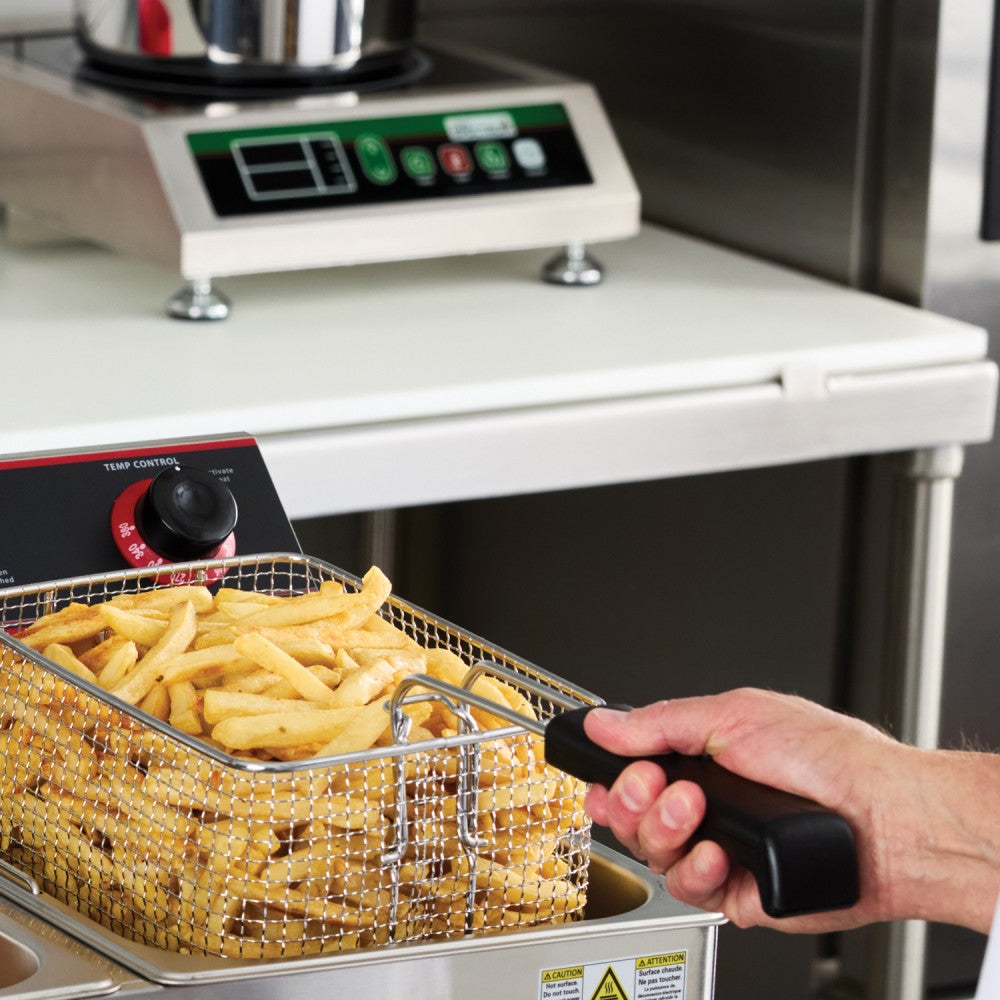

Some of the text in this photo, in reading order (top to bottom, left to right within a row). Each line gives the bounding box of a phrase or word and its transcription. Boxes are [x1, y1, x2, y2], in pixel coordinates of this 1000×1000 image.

[103, 457, 180, 472] TEMP CONTROL
[647, 954, 684, 965] ATTENTION
[552, 968, 583, 979] CAUTION
